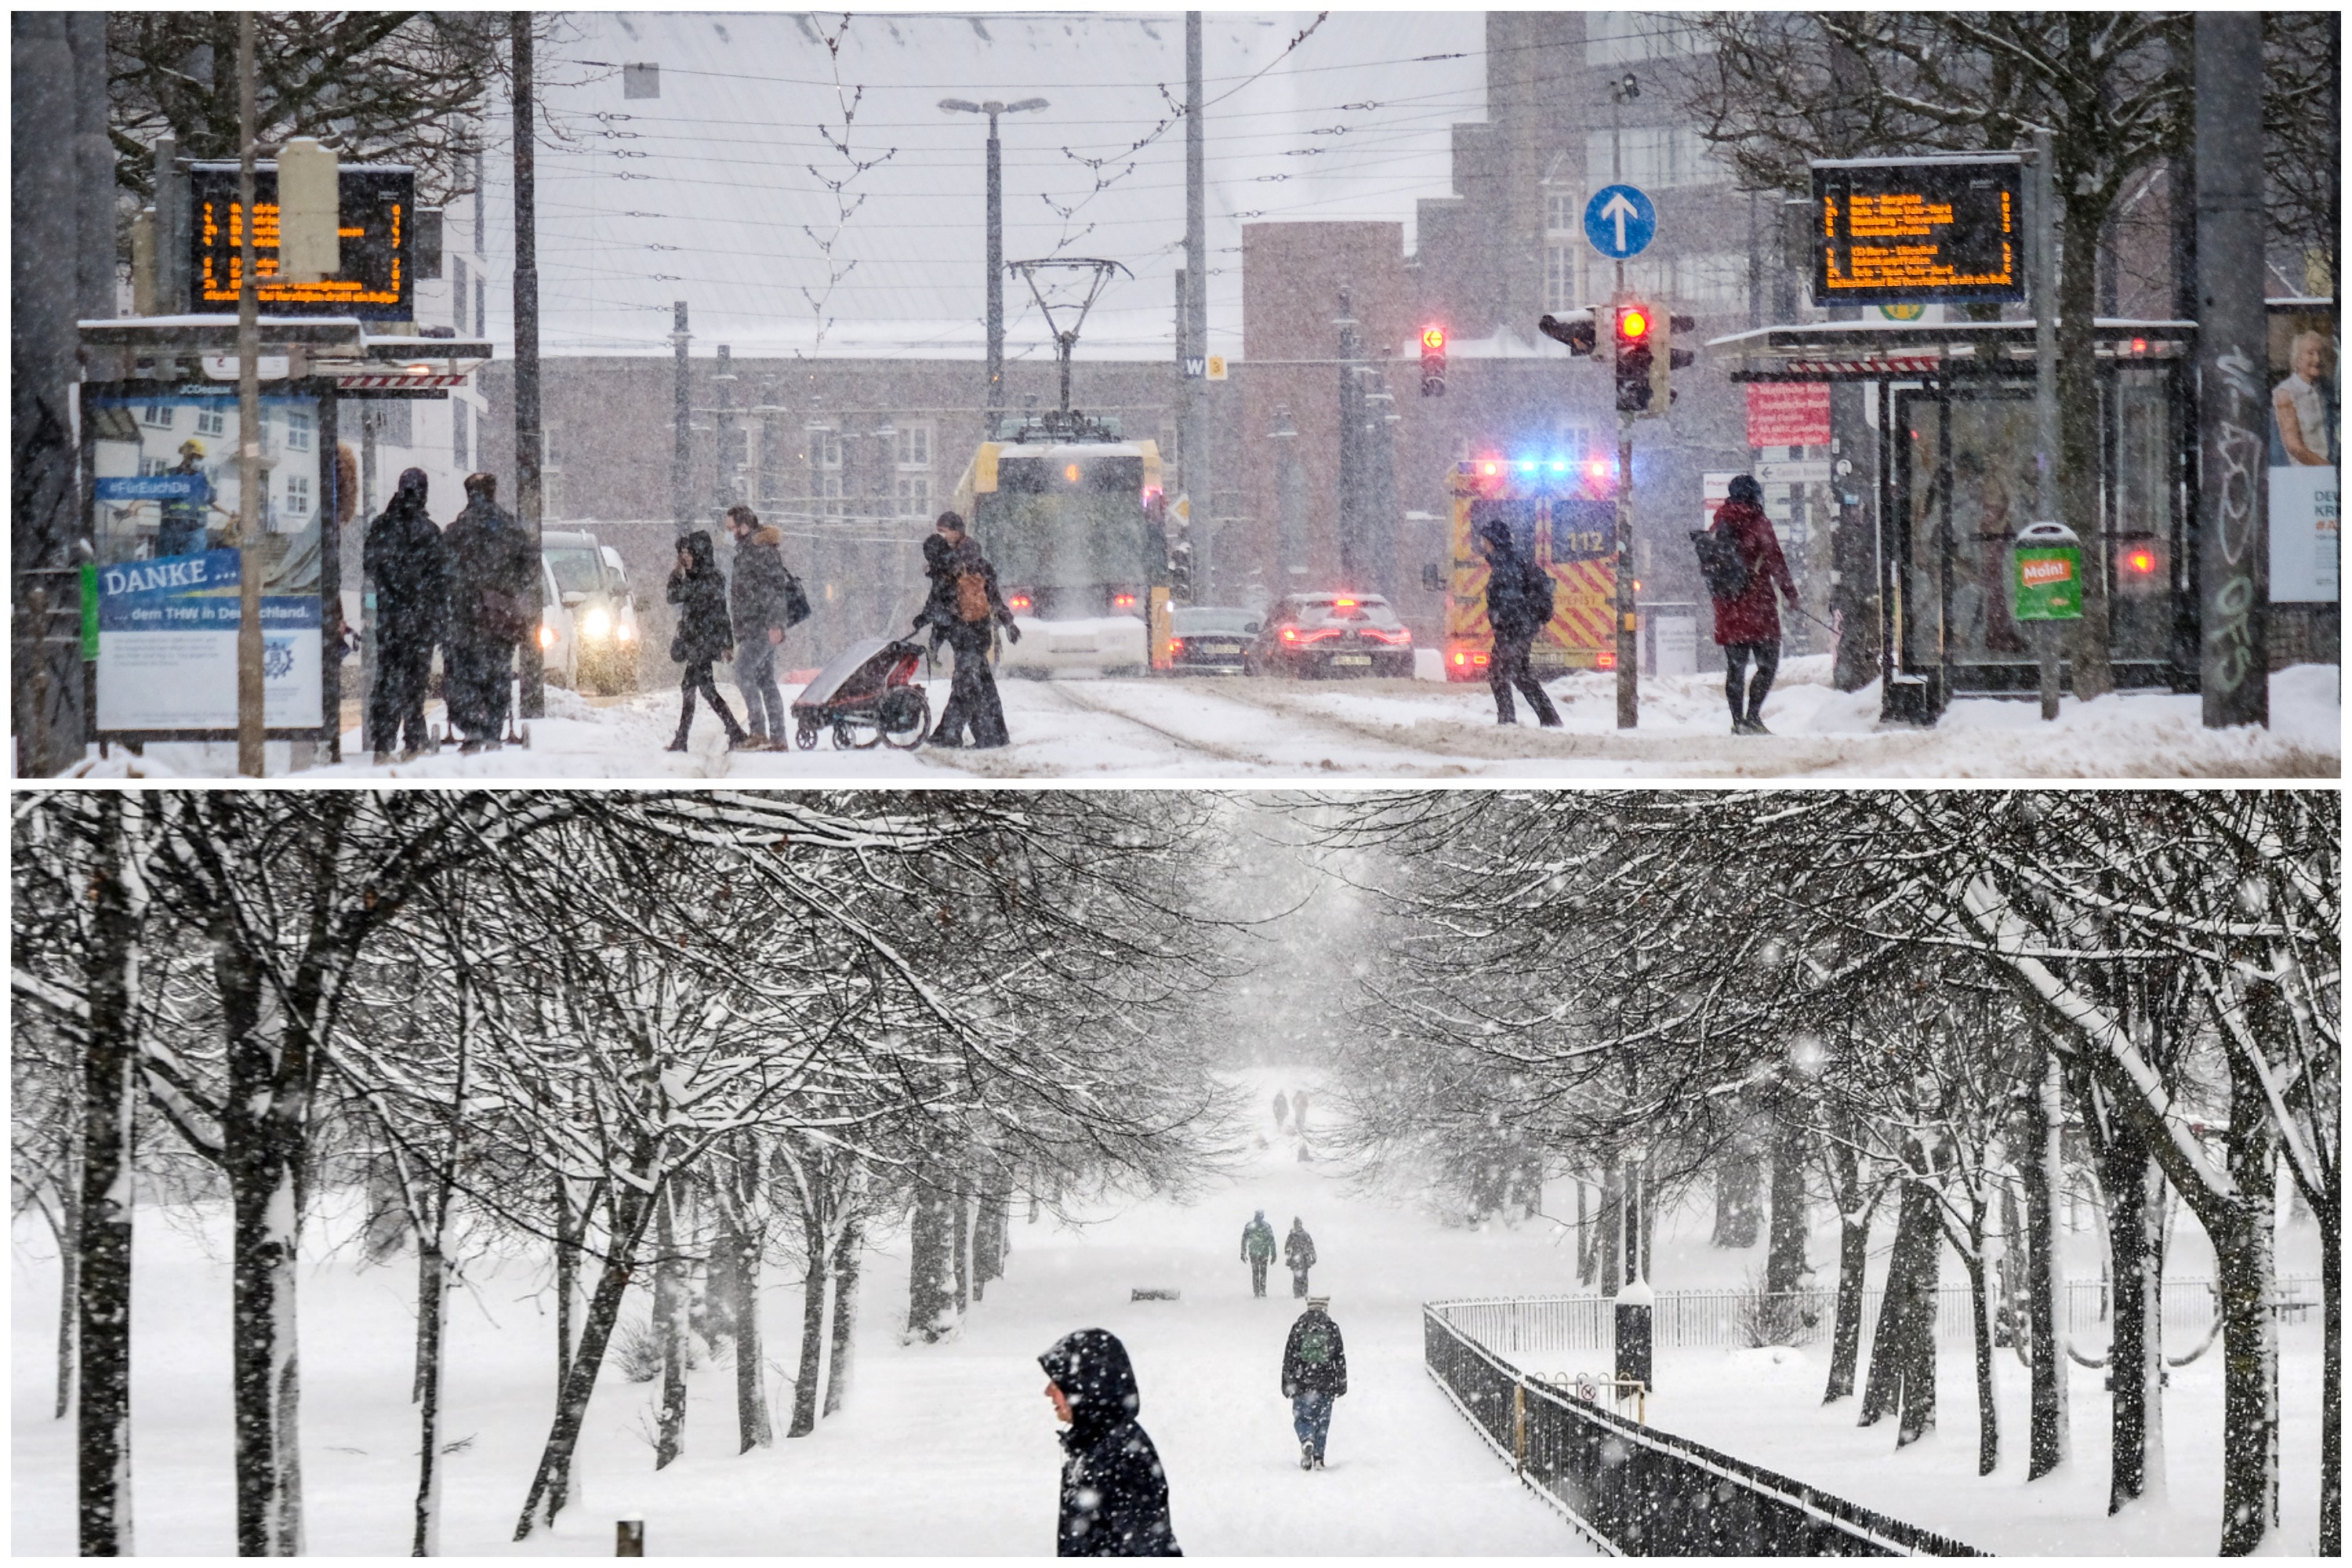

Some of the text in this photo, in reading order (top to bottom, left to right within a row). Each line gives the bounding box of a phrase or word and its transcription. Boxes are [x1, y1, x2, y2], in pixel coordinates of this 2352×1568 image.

[1186, 359, 1203, 375] W
[1567, 531, 1605, 552] 112
[104, 559, 209, 596] DANKE
[2024, 562, 2064, 580] Moin!
[131, 607, 162, 621] dem
[164, 607, 199, 622] THW
[201, 607, 216, 620] in
